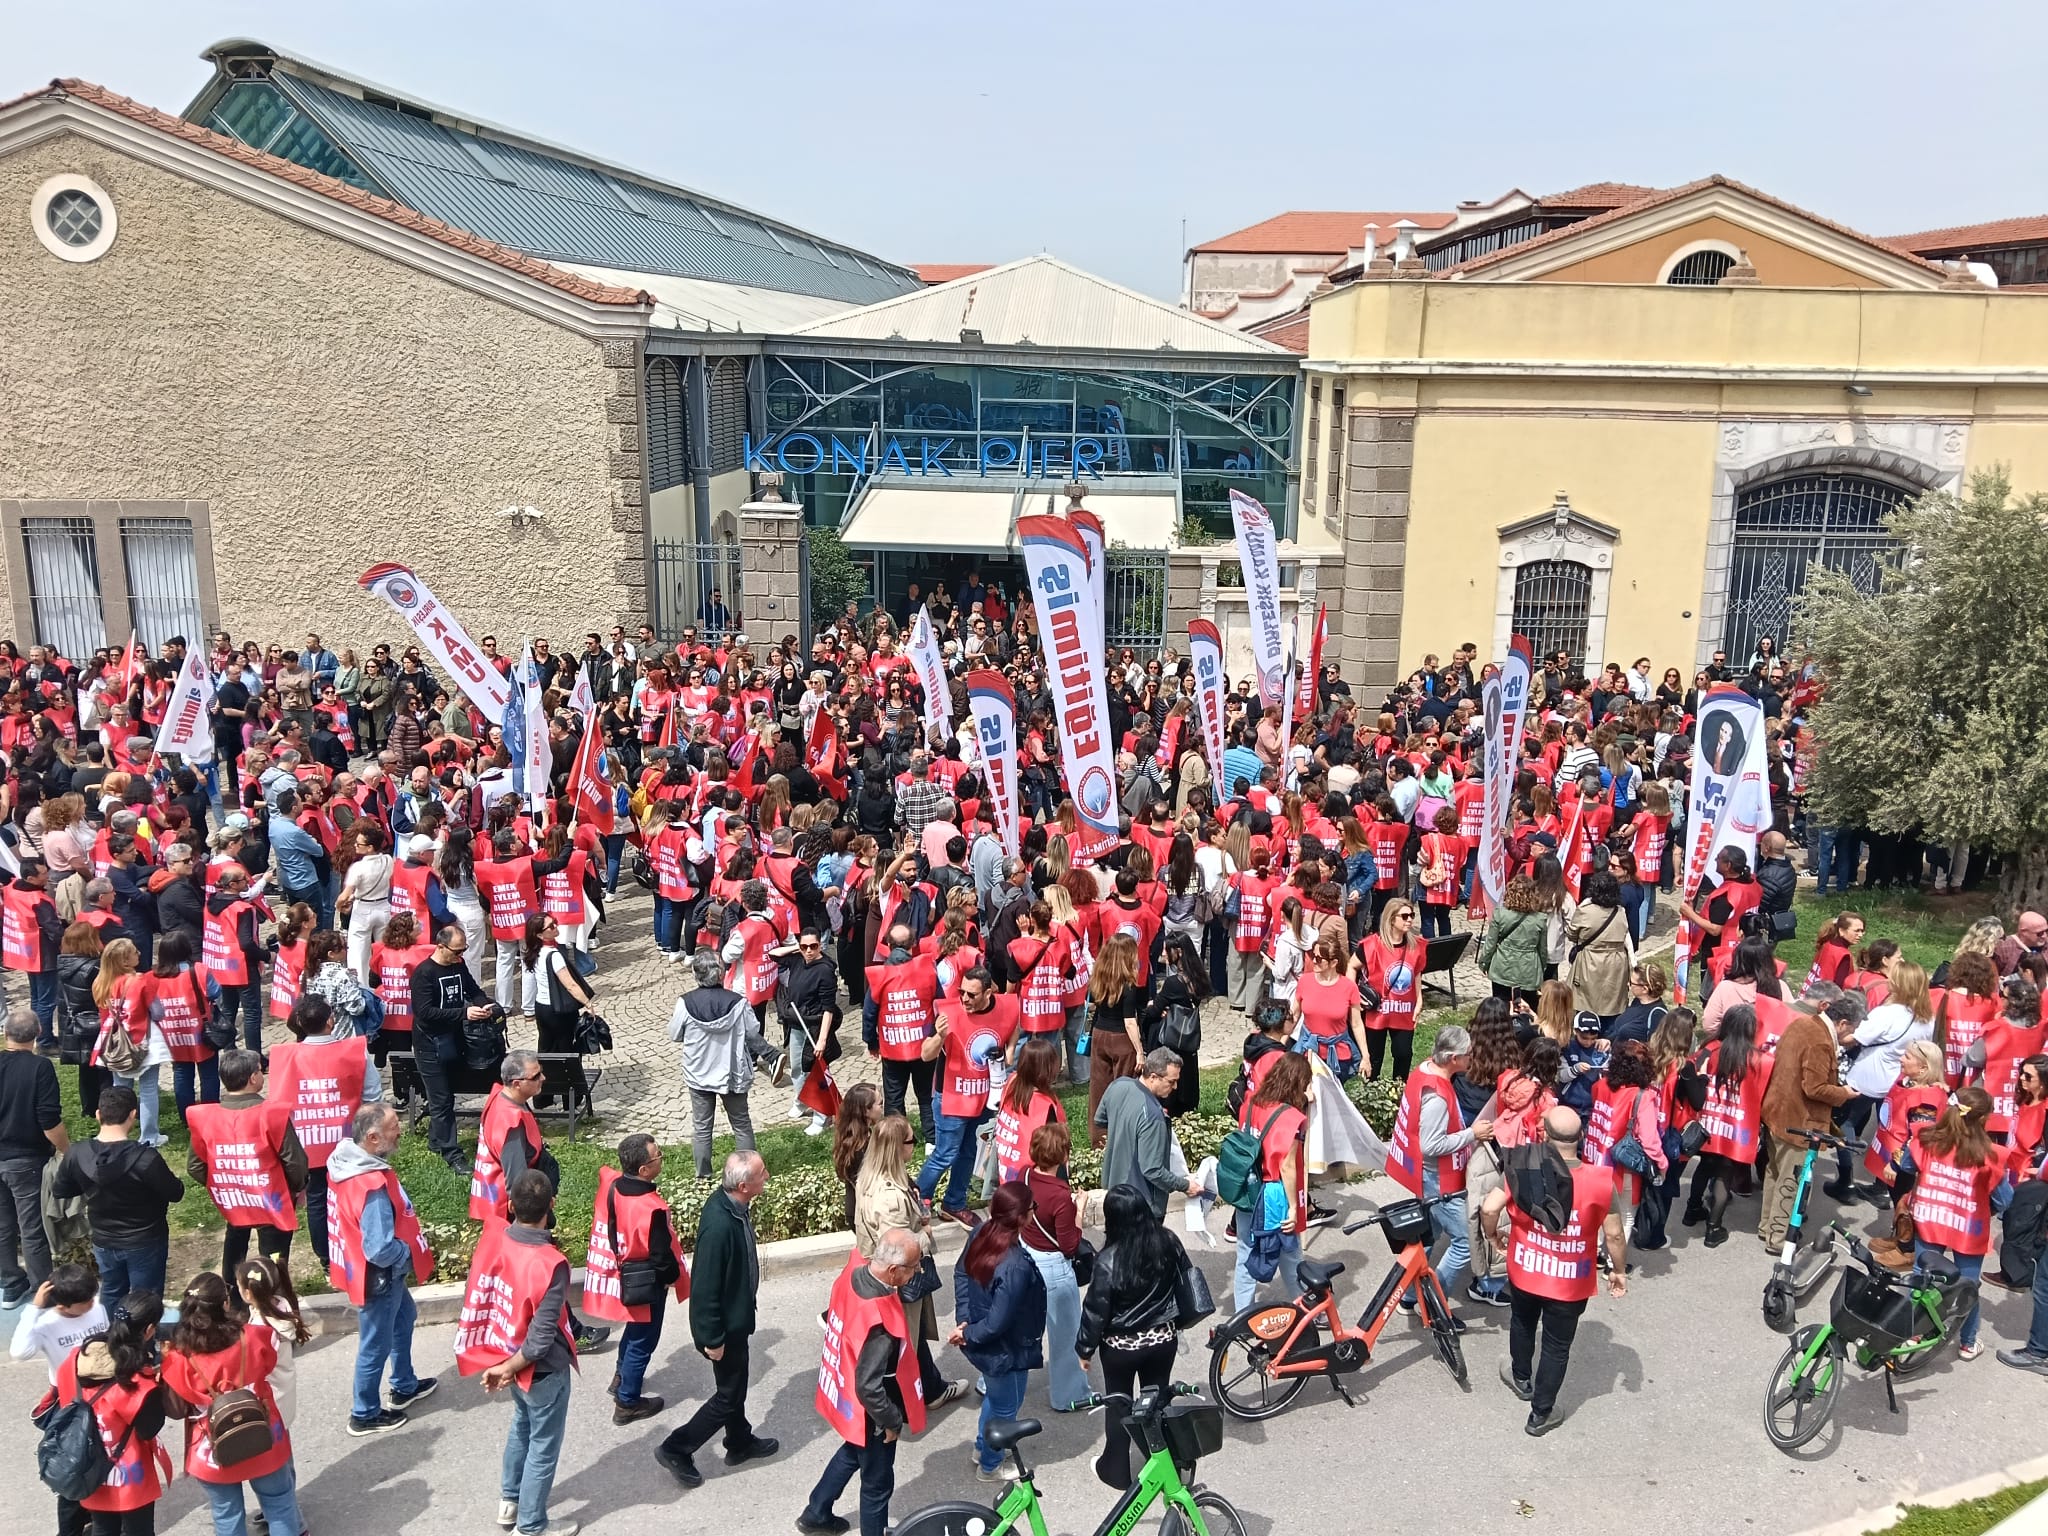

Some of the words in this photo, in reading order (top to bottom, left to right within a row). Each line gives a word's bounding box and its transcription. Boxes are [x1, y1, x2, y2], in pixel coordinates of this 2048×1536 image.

[743, 431, 953, 476] KONAK
[981, 437, 1104, 481] PIER
[887, 989, 917, 1001] EMEK
[887, 999, 921, 1012] EYLEM
[299, 1078, 338, 1091] EMEK
[297, 1091, 341, 1104] EYLEM
[293, 1105, 350, 1121] DİRENİŞ
[215, 1143, 256, 1156] EMEK
[215, 1158, 260, 1170] EYLEM
[1929, 1161, 1972, 1182] EMEK
[212, 1172, 270, 1187] DİRENİŞ
[1527, 1231, 1586, 1254] DİRENİŞ
[1387, 1285, 1403, 1308] tripy
[1269, 1311, 1291, 1324] tripy
